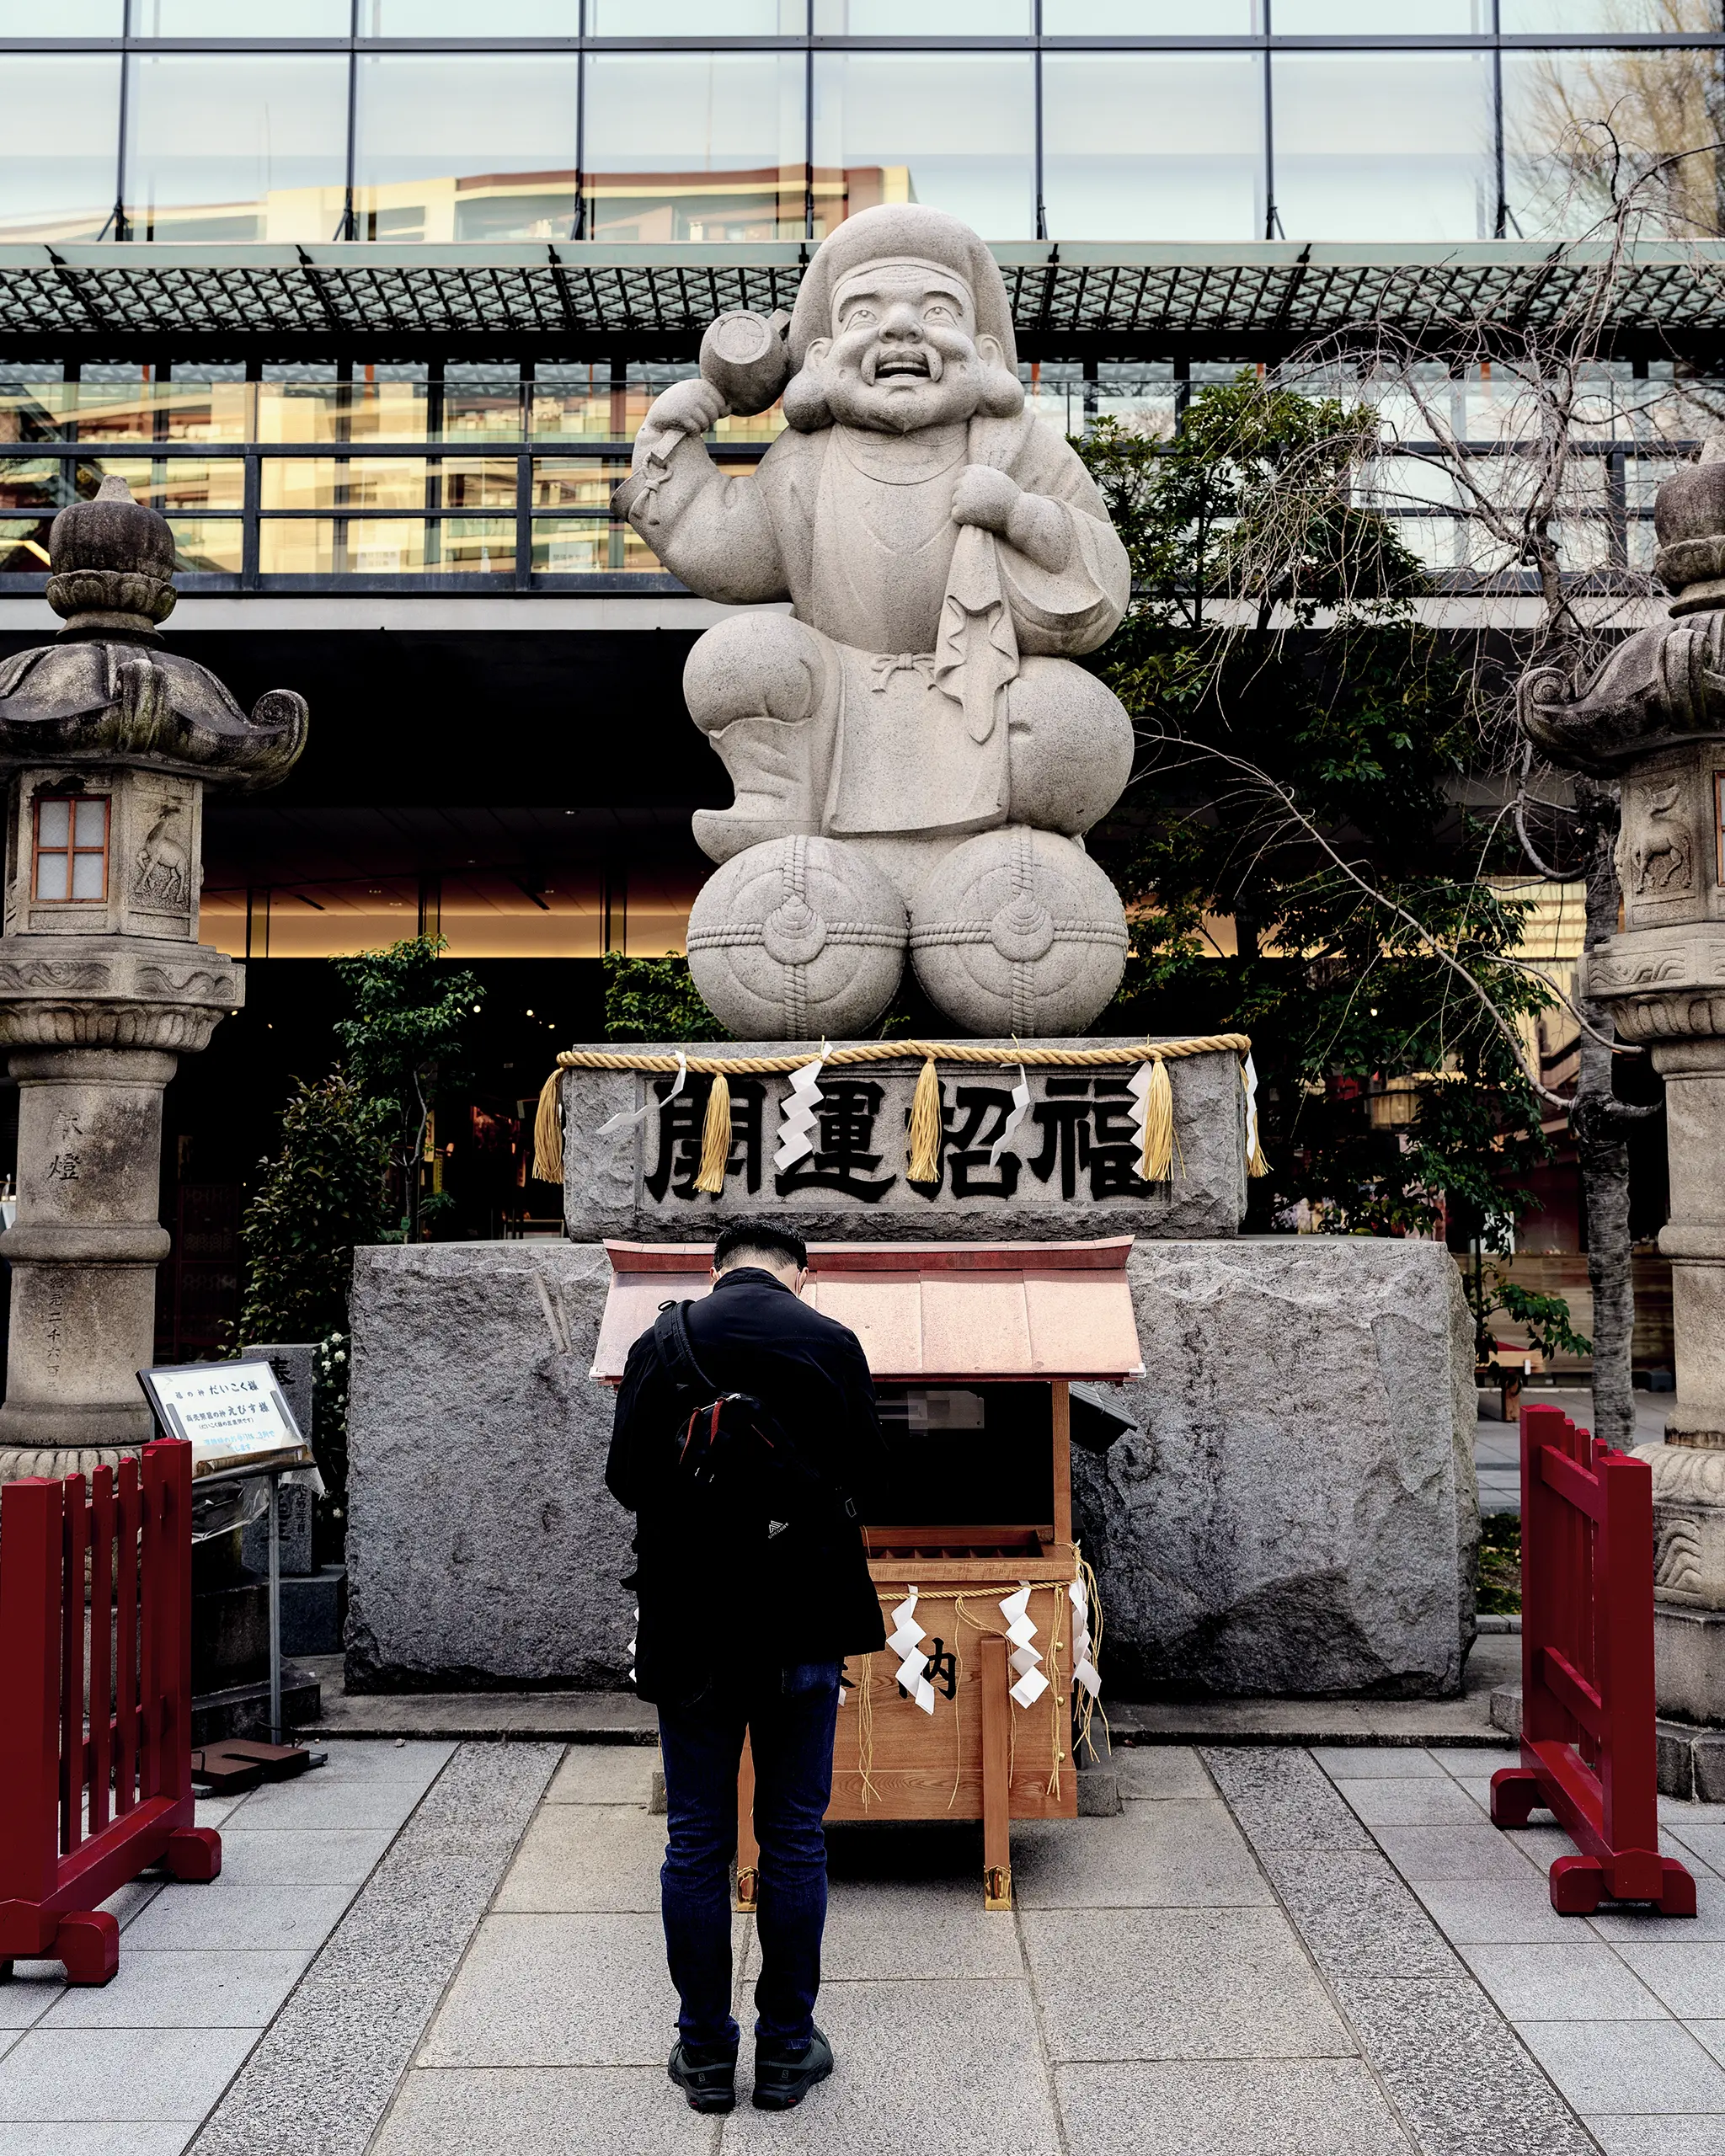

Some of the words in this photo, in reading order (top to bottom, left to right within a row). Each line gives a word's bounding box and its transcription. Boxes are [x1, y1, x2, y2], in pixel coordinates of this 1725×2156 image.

[644, 1076, 1156, 1203] 開運招福
[209, 1380, 259, 1395] だいこく様
[227, 1401, 270, 1417] えびす様
[767, 1522, 790, 1540] GREGORY
